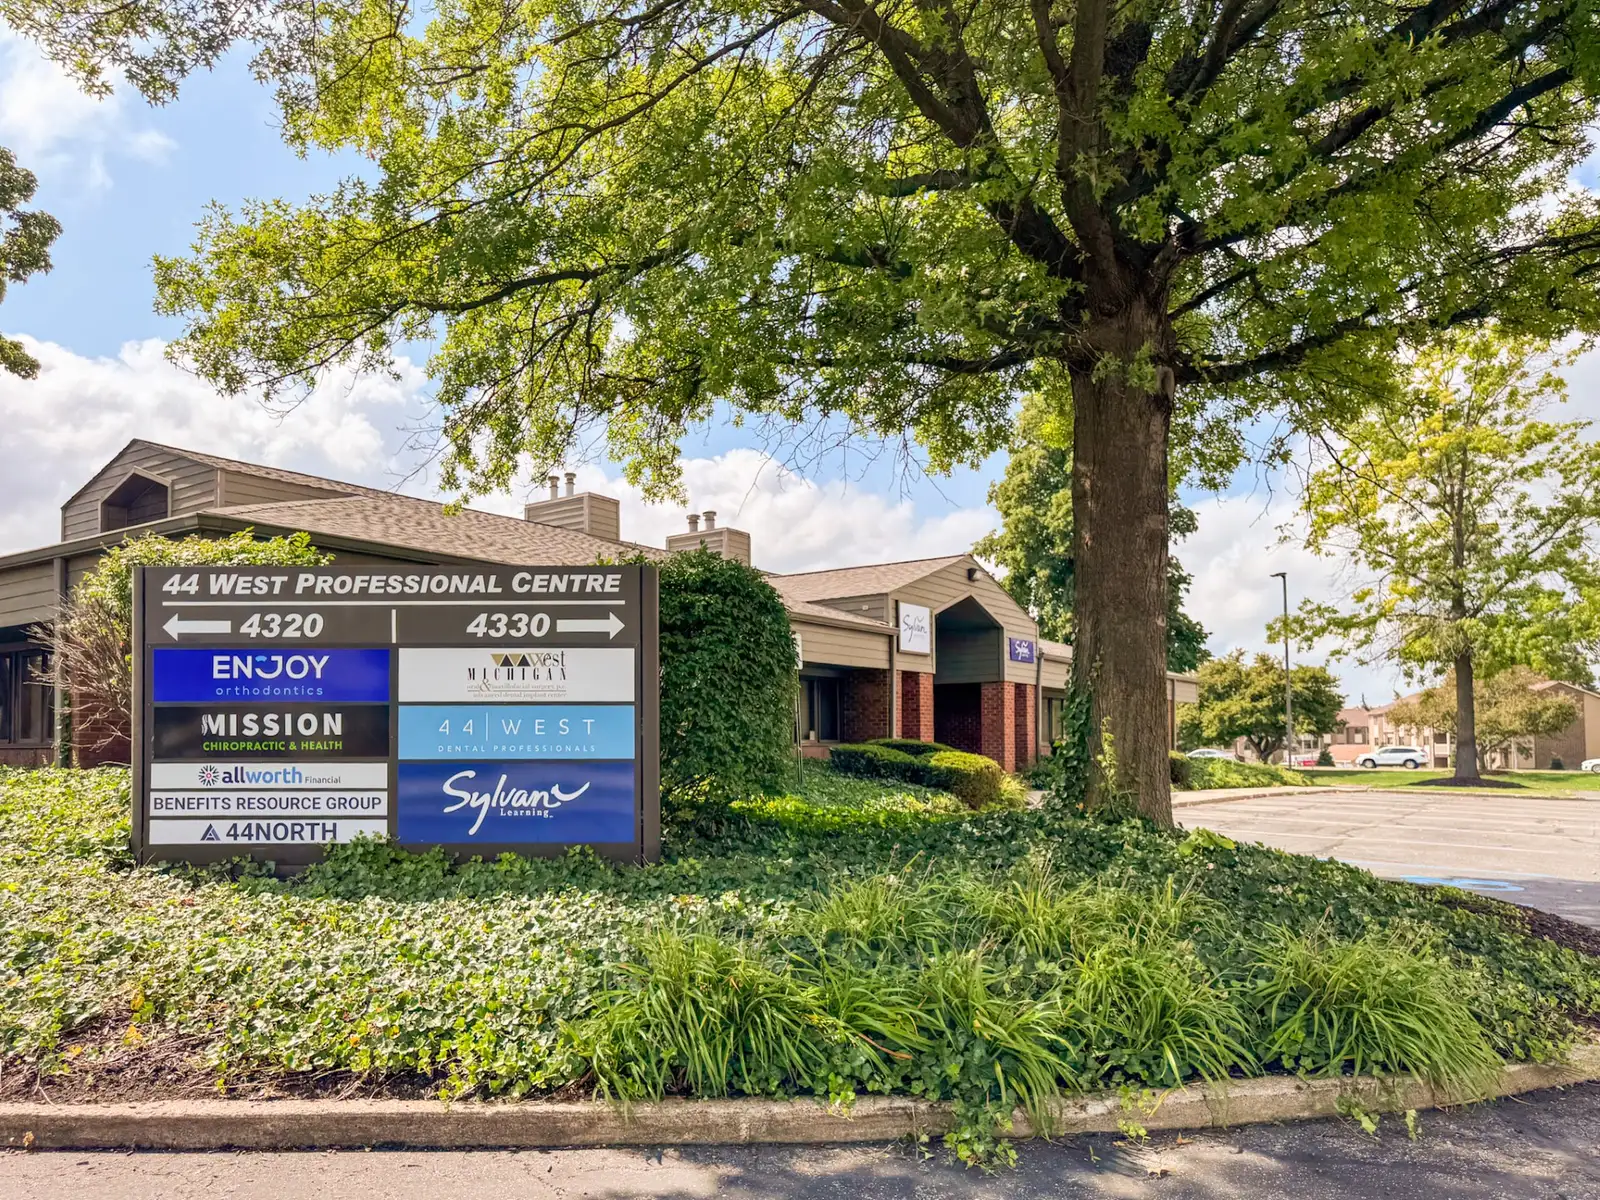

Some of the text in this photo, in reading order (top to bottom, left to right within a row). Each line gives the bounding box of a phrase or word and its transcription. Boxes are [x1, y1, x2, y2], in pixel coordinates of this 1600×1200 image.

[162, 572, 622, 595] 44 WEST PROFESSIONAL CENTRE
[239, 613, 324, 638] 4320
[466, 613, 551, 637] 4330
[902, 614, 928, 643] Sylvan
[212, 655, 330, 679] ENJOY
[467, 667, 567, 681] MICHIGAN
[215, 685, 324, 696] orthodontics
[201, 713, 342, 736] MISSION
[501, 719, 596, 735] WEST
[203, 741, 342, 751] CHIROPRACTIC & HEALTH
[222, 766, 341, 784] allworth Financial
[154, 797, 382, 810] BENEFITS RESOURCE GROUP
[442, 770, 590, 836] Sylvan
[500, 808, 549, 818] Learning
[226, 823, 337, 841] 44NORTH
